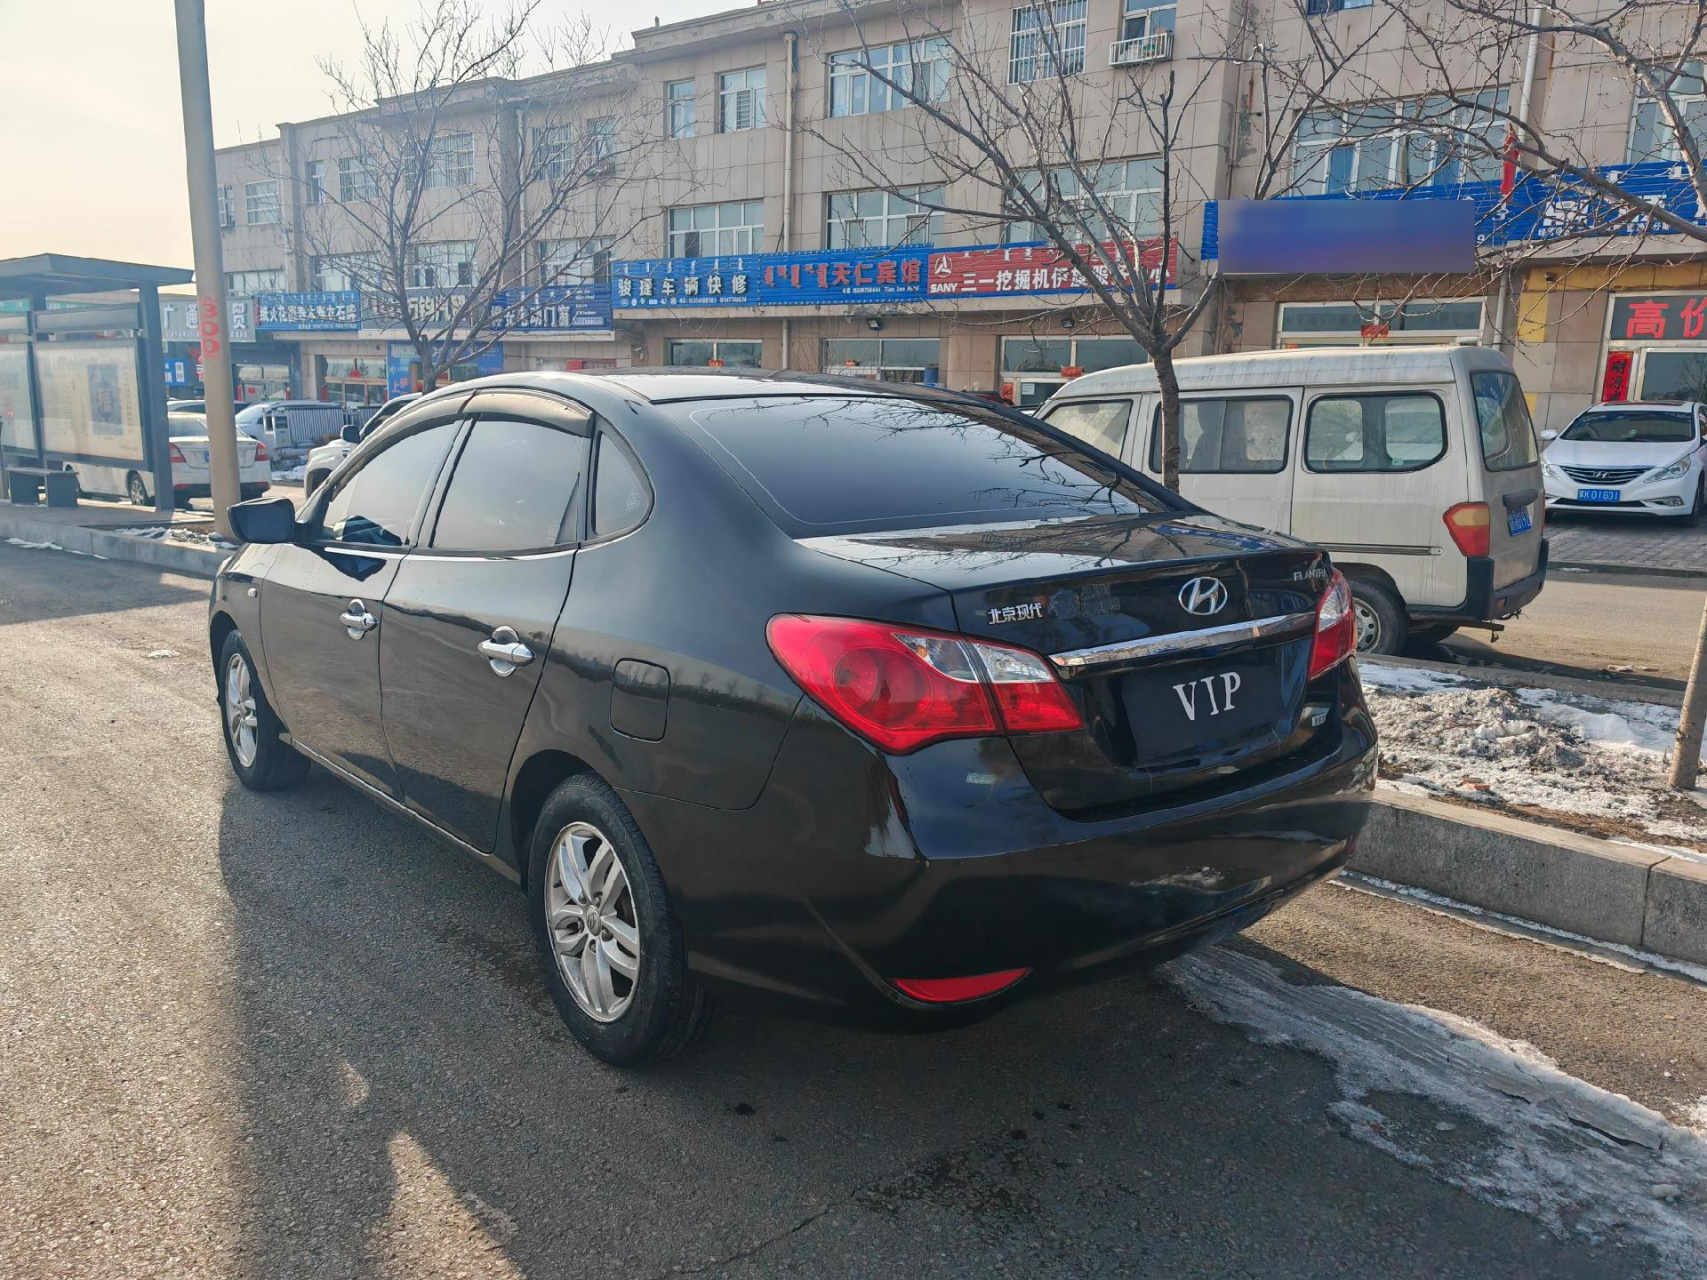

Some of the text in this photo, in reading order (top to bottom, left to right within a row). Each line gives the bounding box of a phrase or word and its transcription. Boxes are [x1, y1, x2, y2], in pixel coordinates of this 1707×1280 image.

[832, 258, 922, 286] 天仁宾馆
[930, 282, 958, 294] SANY
[1626, 298, 1707, 339] 高价
[987, 602, 1043, 625] 北京现代
[1172, 671, 1241, 721] VIP
